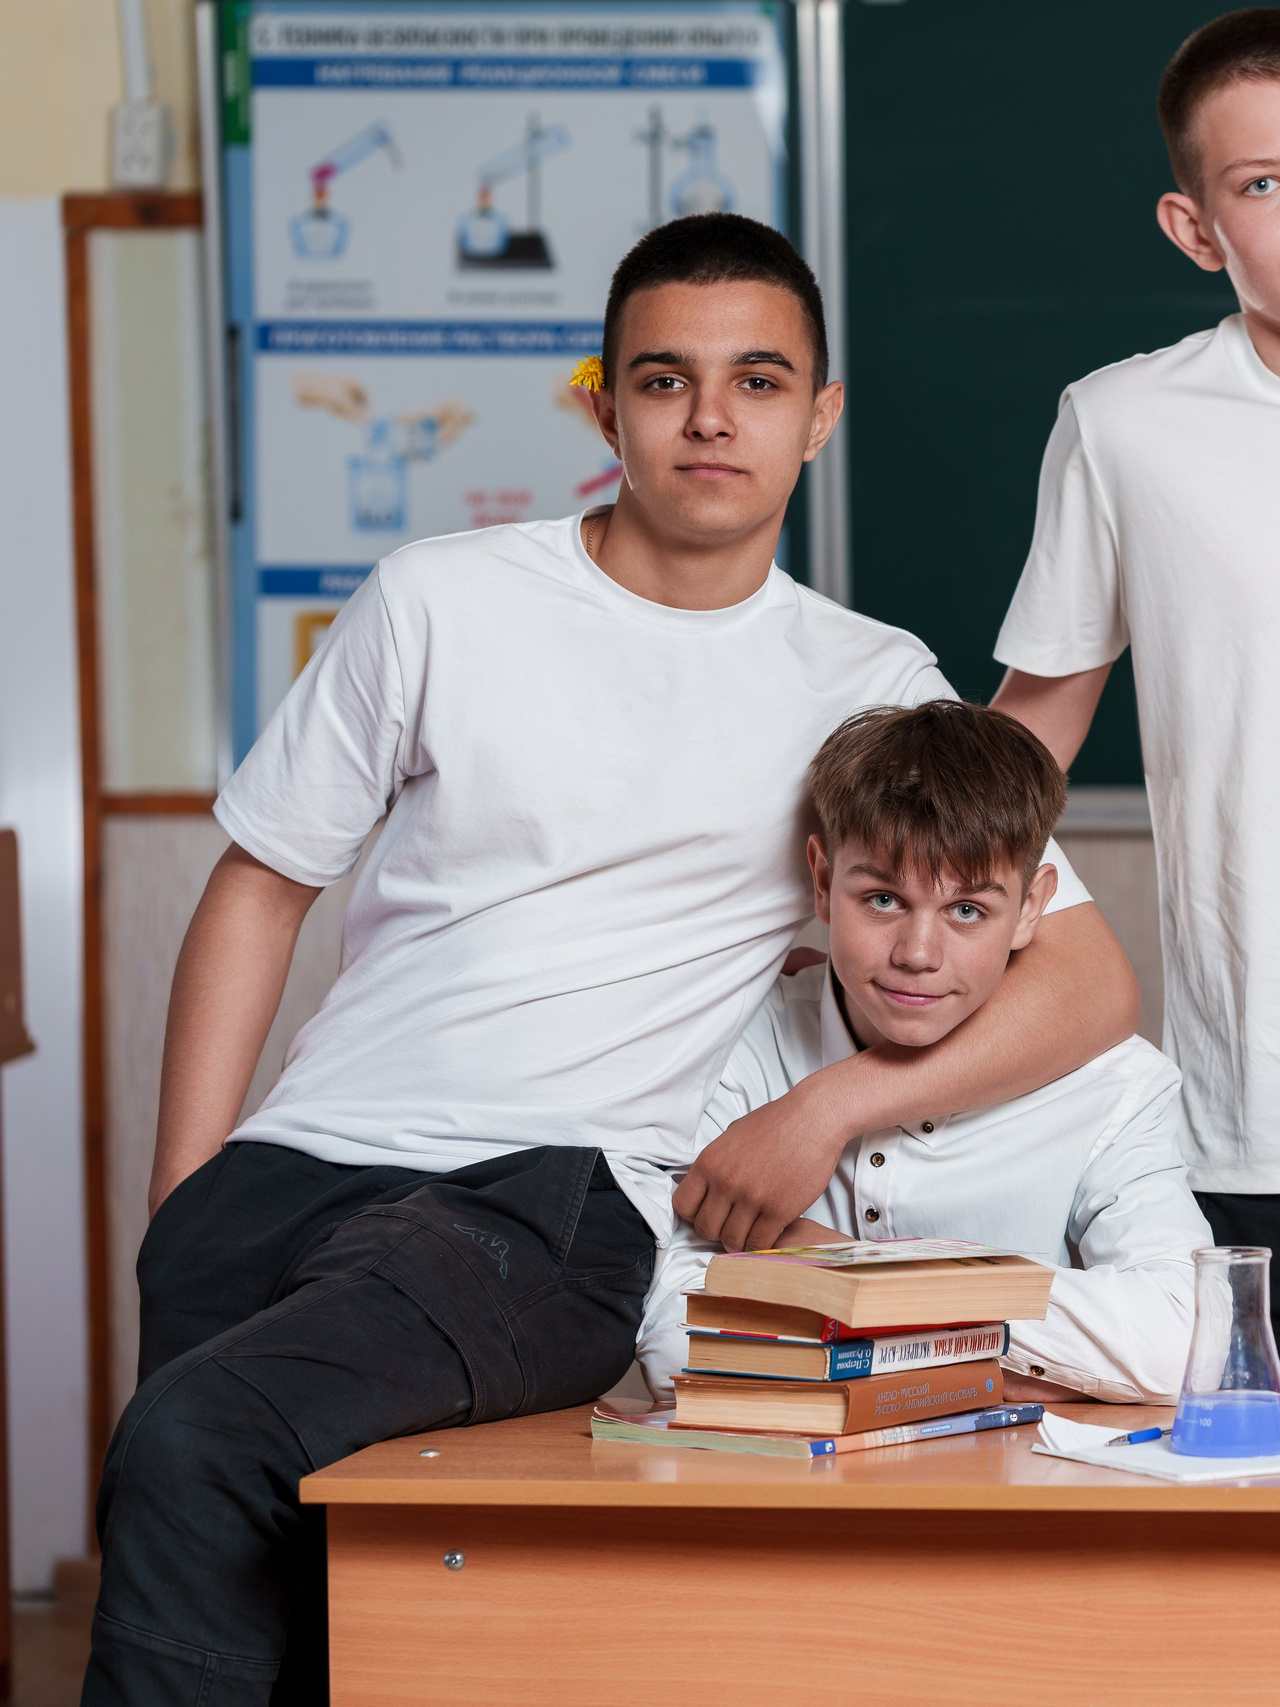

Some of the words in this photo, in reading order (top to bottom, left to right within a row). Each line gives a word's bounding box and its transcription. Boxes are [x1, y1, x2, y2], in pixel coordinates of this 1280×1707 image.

[878, 1340, 932, 1364] ЭКСПРЕСС-КУРС
[933, 1337, 954, 1358] ЯЗЫК
[953, 1331, 1001, 1358] АНГЛИЙСКИЙ
[836, 1359, 862, 1370] Петрова
[874, 1391, 948, 1415] РУССКО-АНГЛИЙСКИЙ
[948, 1386, 978, 1401] СЛОВАРЬ
[875, 1382, 930, 1403] АНГЛО-РУССКИЙ
[1199, 1417, 1212, 1428] 100
